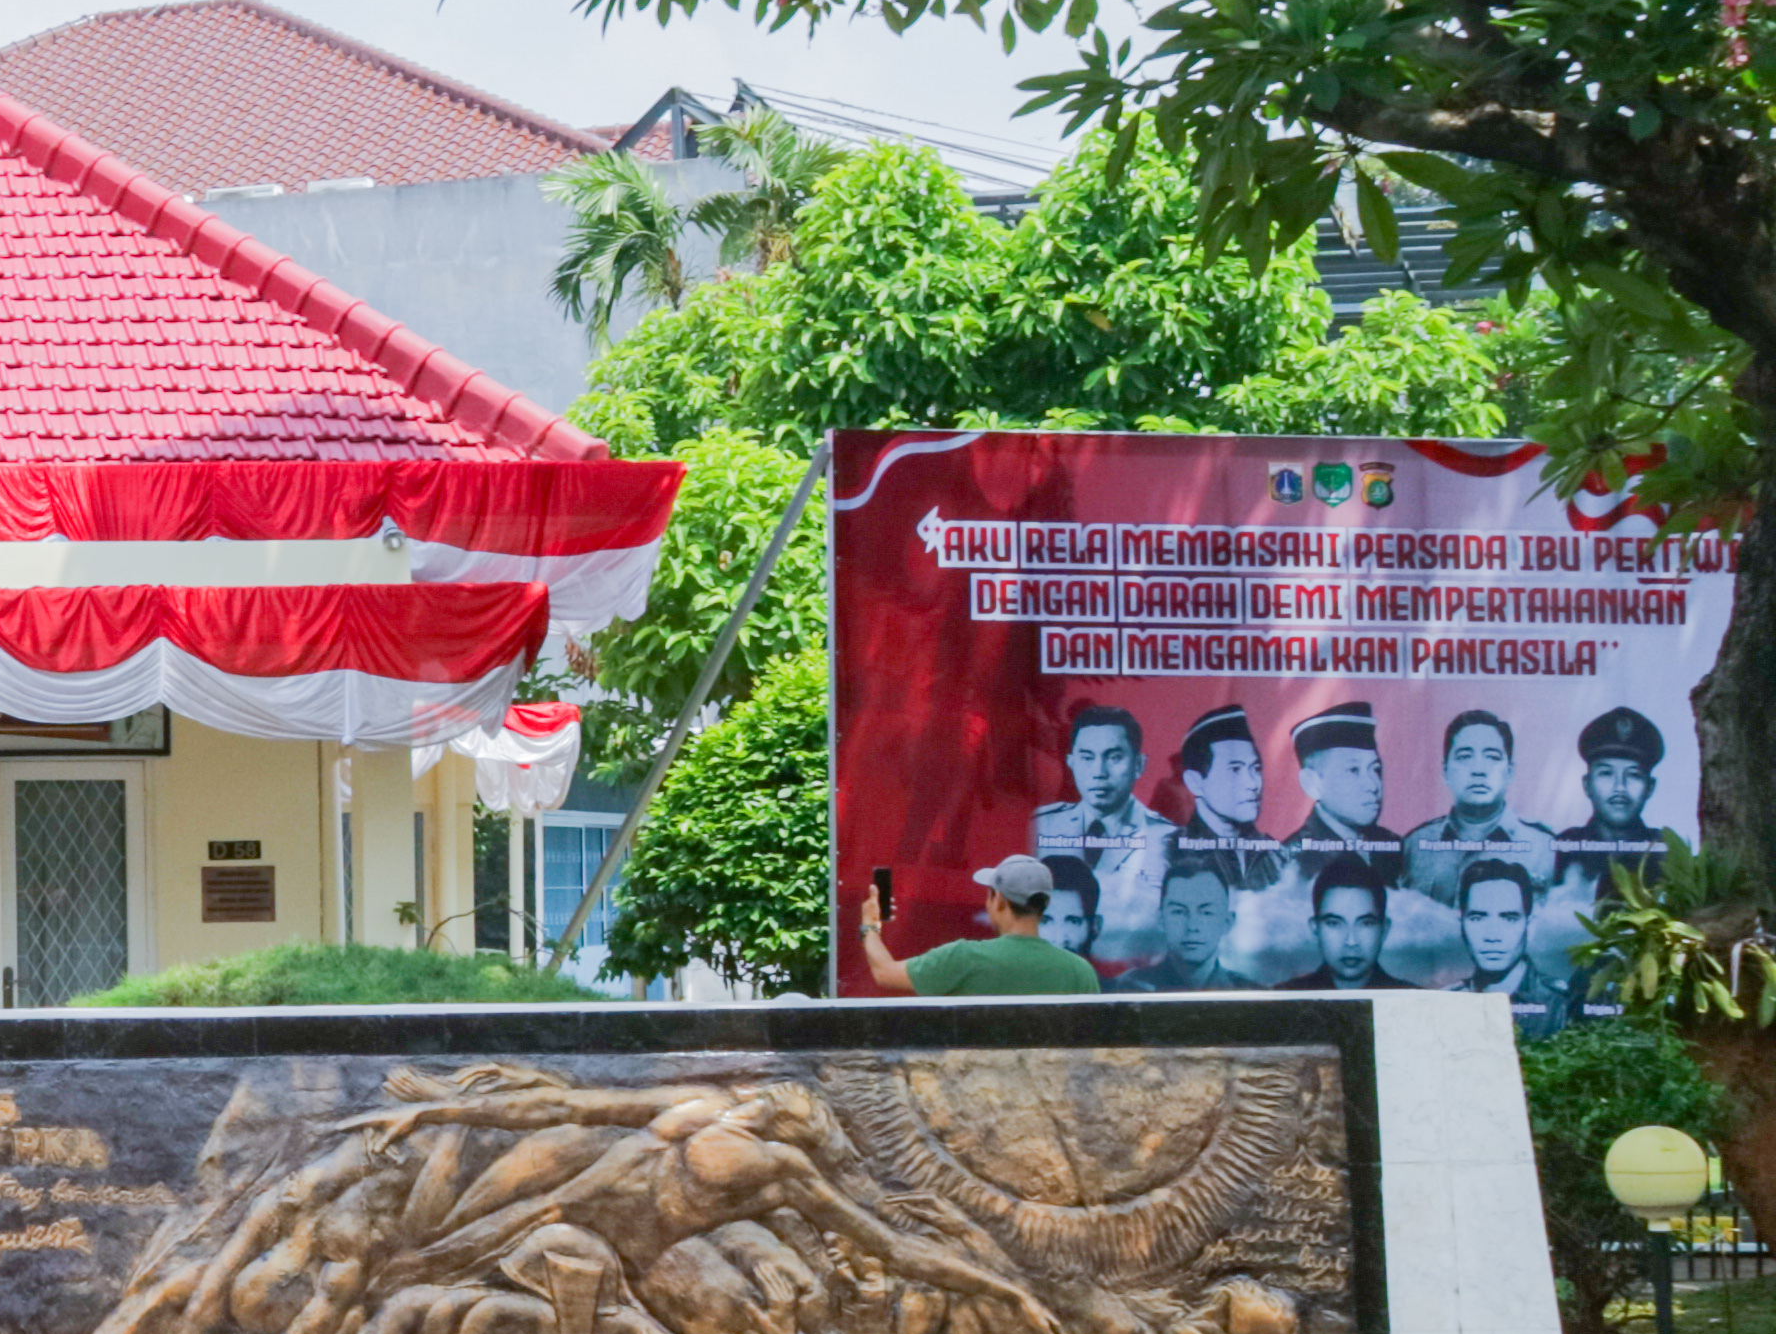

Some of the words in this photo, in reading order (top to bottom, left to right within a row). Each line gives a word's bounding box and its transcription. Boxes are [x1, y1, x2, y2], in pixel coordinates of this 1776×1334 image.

[1026, 528, 1108, 565] RELA
[1121, 529, 1340, 568] MEMBASAHI
[1354, 532, 1507, 570] PERSADA
[1519, 535, 1580, 572] IBU
[976, 578, 1110, 617] DENGAN
[1123, 580, 1237, 619] DARAH
[1250, 583, 1343, 621] DEMI
[1356, 584, 1687, 625] MEMPERTAHANKAN
[1046, 631, 1114, 669] DAN
[1126, 634, 1398, 674] MENGAMALKAN
[1177, 836, 1216, 851] Mayjen
[1300, 837, 1344, 852] Mayjen
[1355, 839, 1401, 852] Parman
